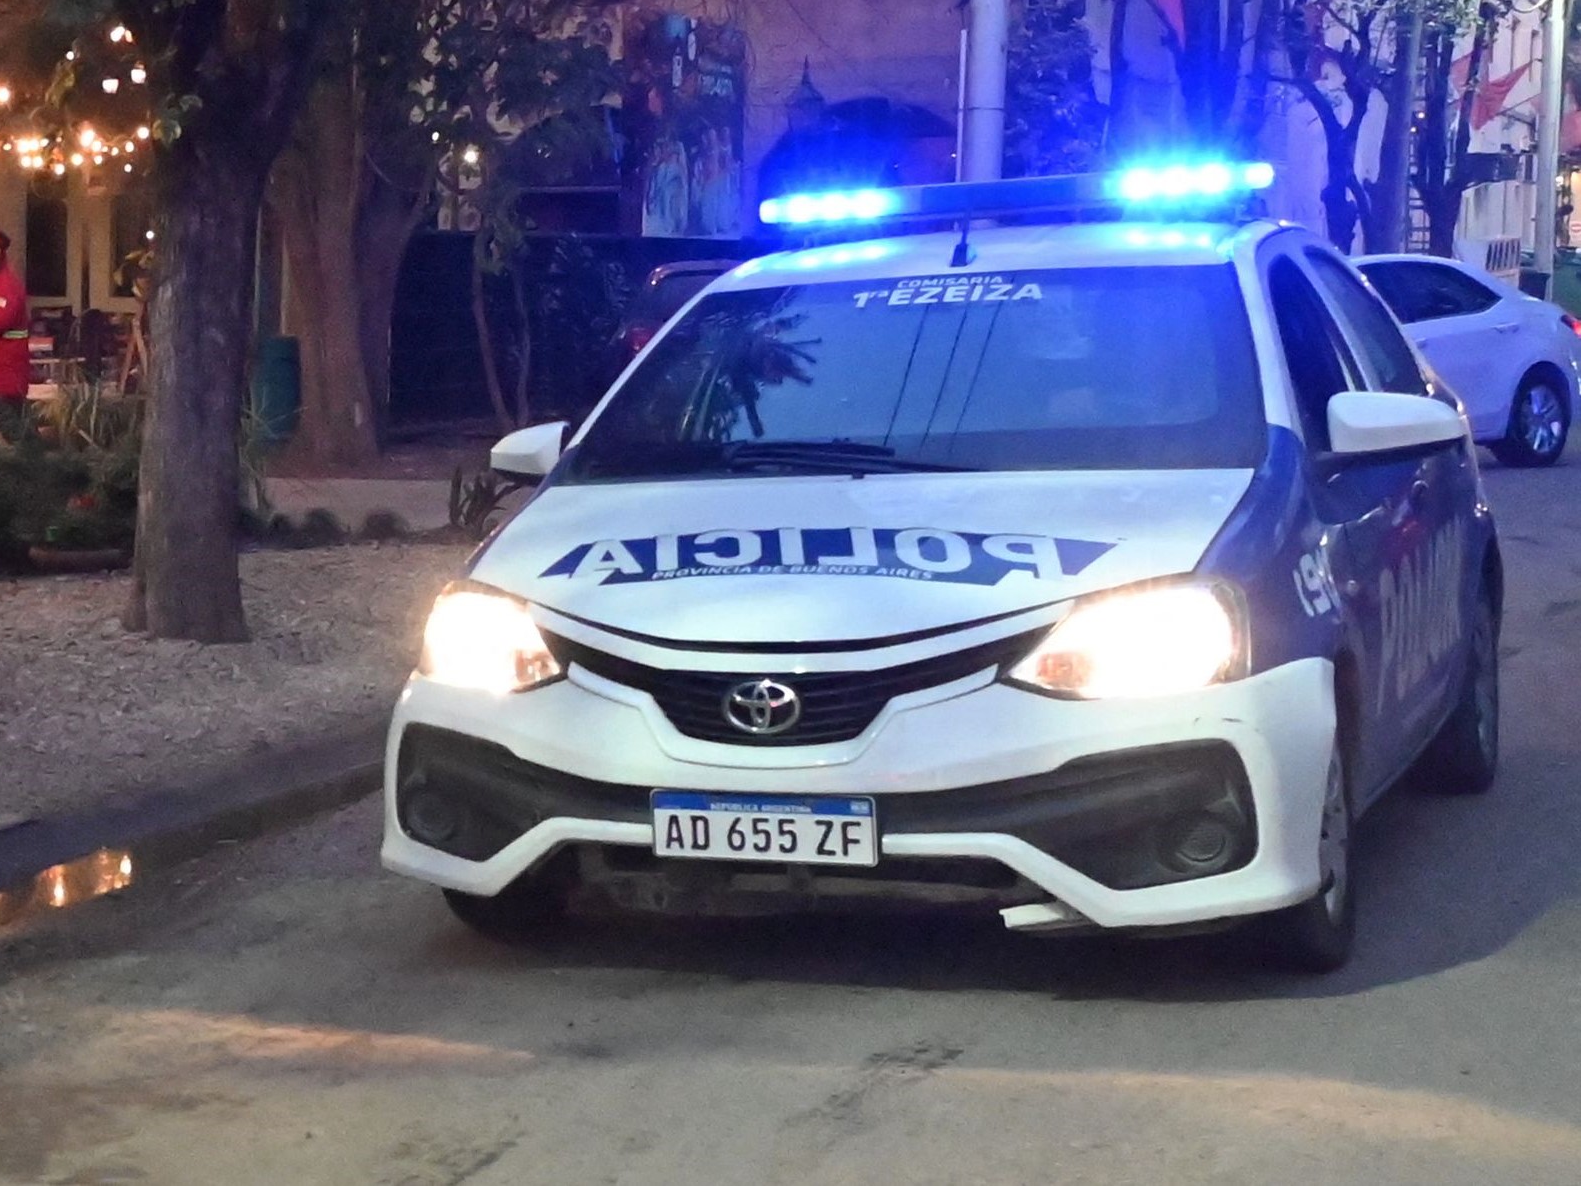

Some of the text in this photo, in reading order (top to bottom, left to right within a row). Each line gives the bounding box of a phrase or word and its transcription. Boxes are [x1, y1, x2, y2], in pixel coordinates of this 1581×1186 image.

[887, 283, 1043, 306] EZEIZA
[651, 564, 932, 581] PROVINCIA DE BUENOS AIRES
[665, 813, 862, 857] AD 655 ZF
